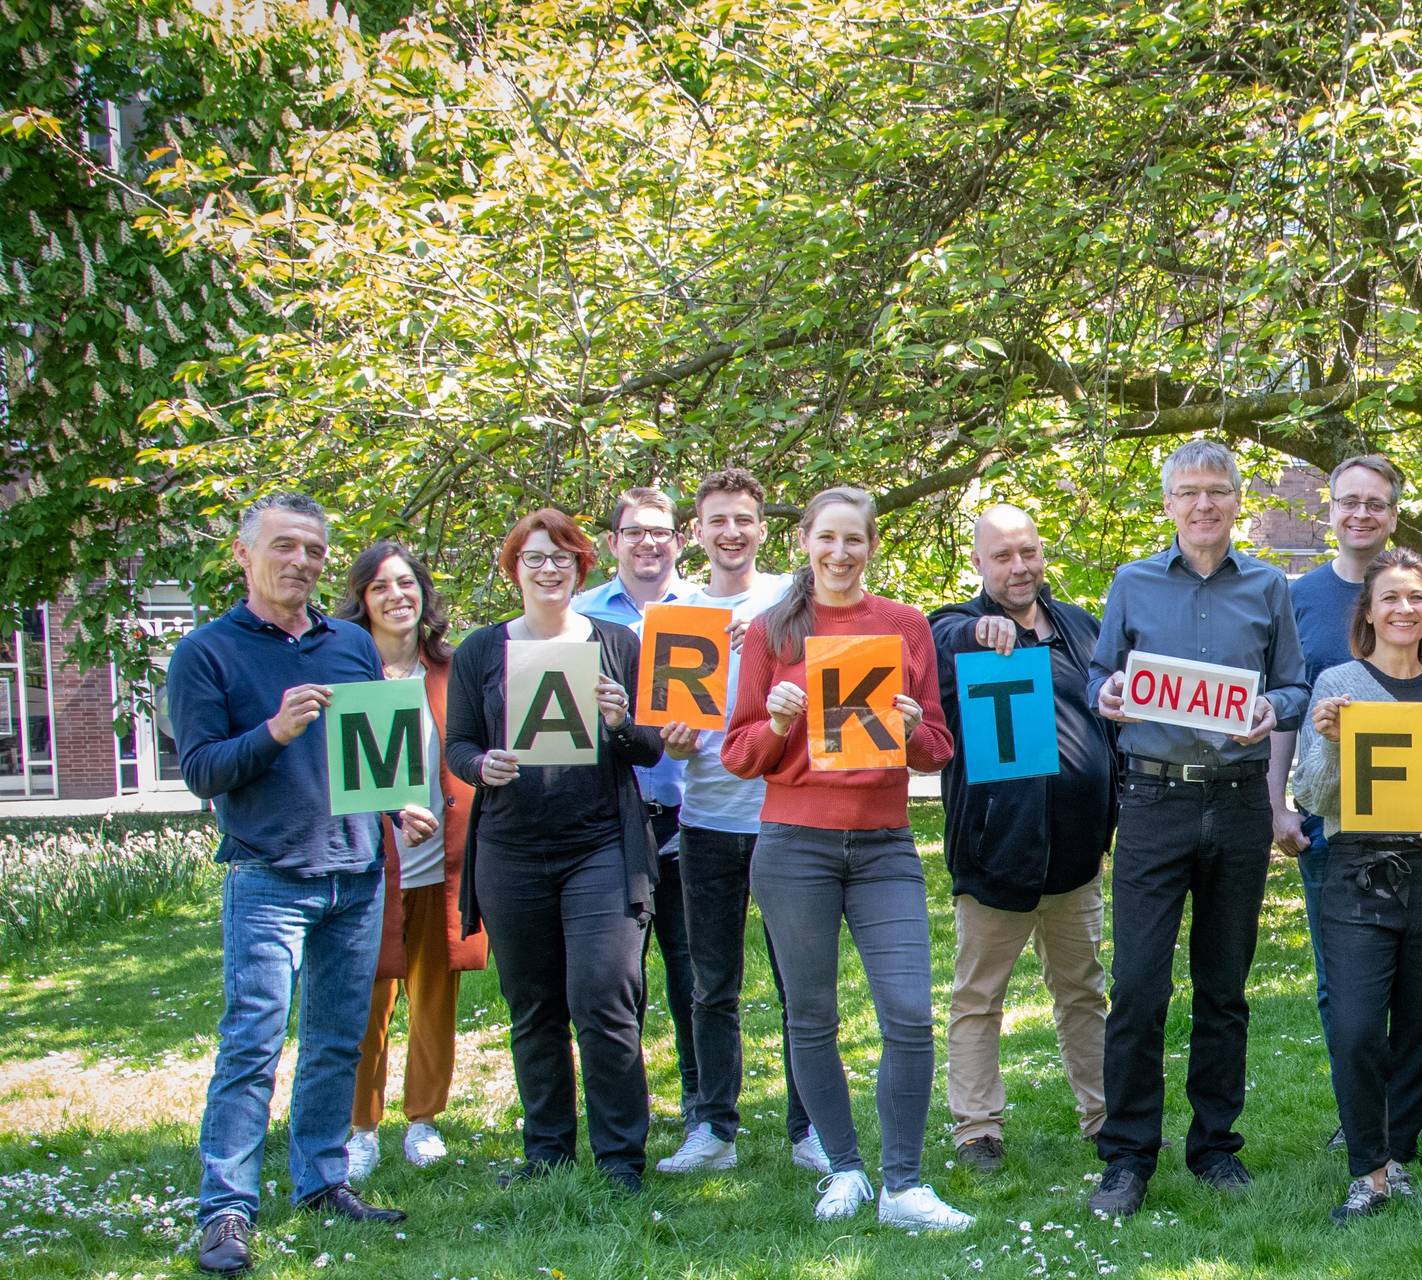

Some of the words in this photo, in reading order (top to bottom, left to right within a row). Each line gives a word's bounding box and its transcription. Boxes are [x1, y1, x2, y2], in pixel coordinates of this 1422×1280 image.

[513, 670, 594, 750] A
[651, 632, 721, 716] R
[822, 667, 900, 753] K
[1131, 669, 1182, 711] ON
[1187, 680, 1249, 722] AIR
[340, 708, 424, 791] M
[968, 679, 1034, 763] T
[1355, 733, 1412, 815] F
